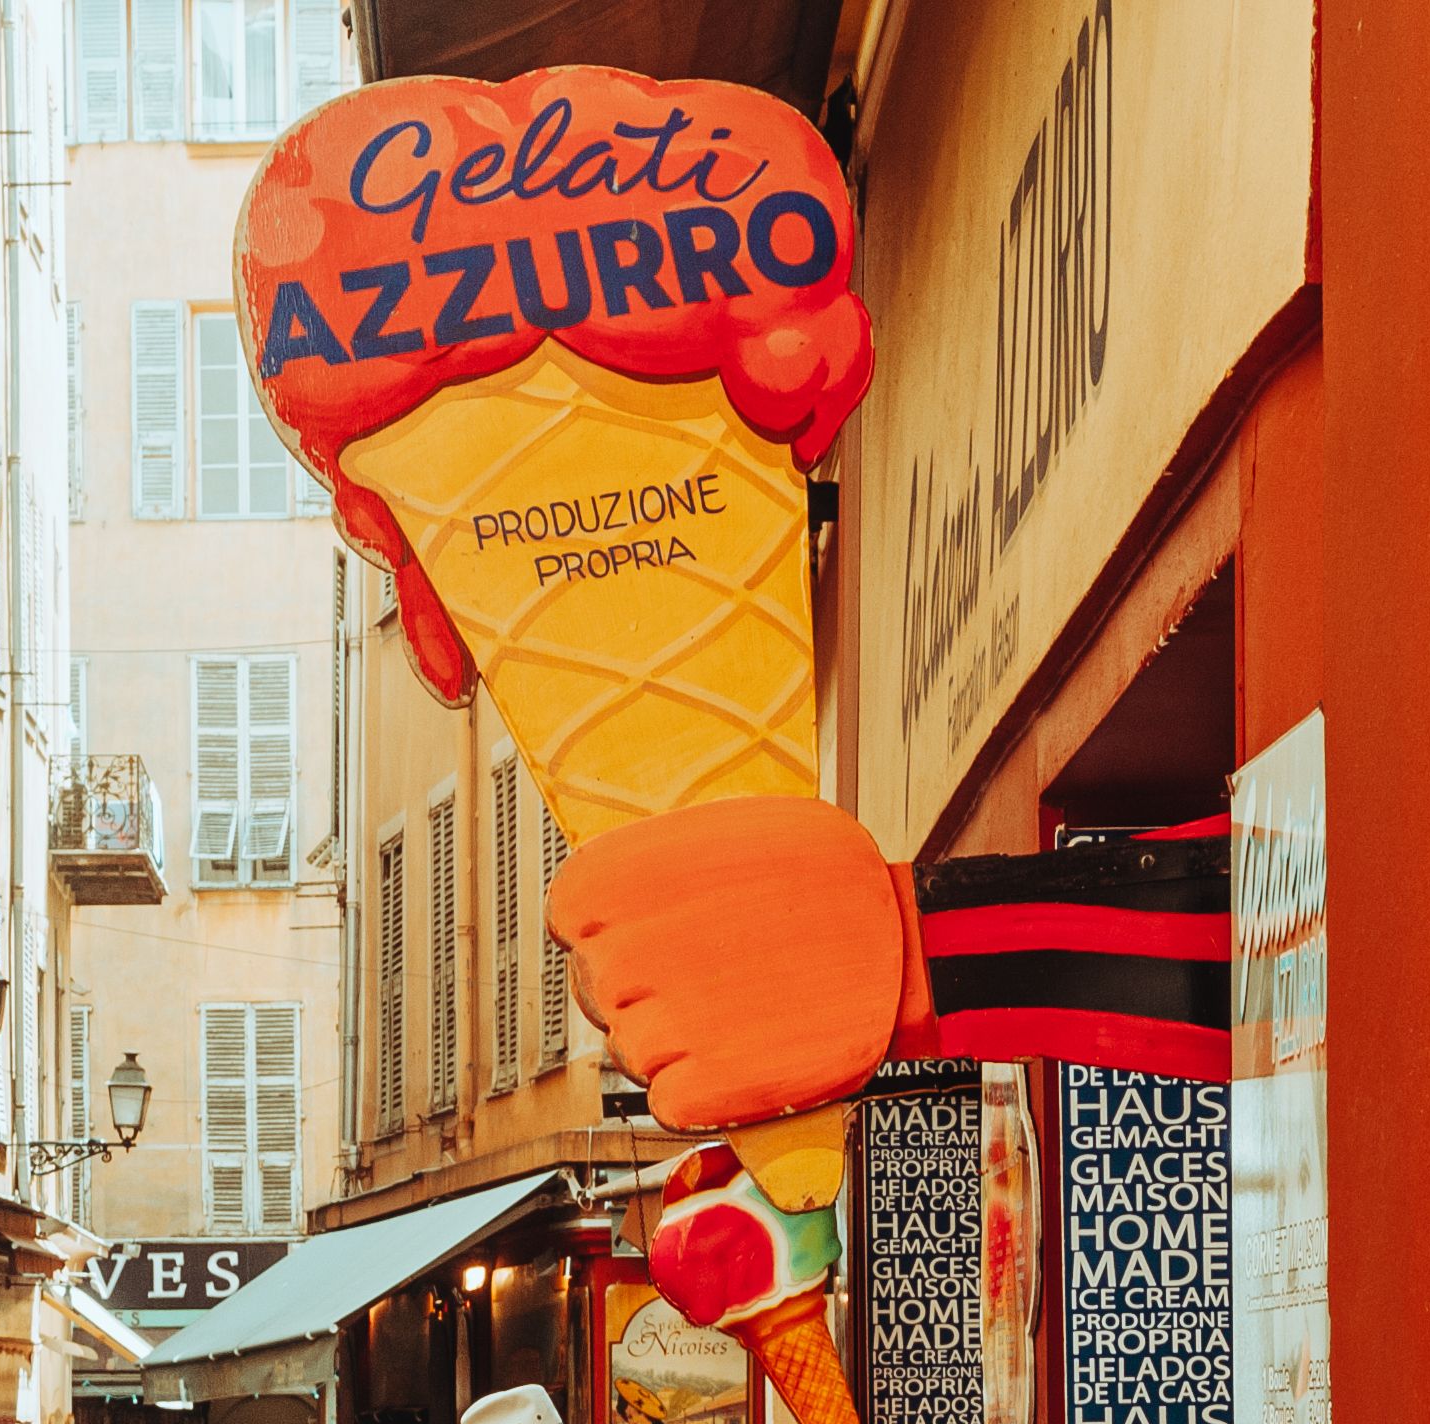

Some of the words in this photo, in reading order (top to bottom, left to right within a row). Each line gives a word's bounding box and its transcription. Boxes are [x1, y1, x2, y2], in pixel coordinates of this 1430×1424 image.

[349, 97, 770, 244] Gelati
[260, 190, 837, 380] AZZURRO
[901, 428, 982, 832] Gelateria
[990, 0, 1112, 576] AZZURRO
[472, 474, 727, 550] PRODUZIONE
[535, 534, 696, 587] PROPRIA
[989, 591, 1020, 696] Maison
[1069, 1065, 1105, 1087] DE
[871, 1105, 979, 1131] MADE
[1070, 1086, 1227, 1126] HAUS
[870, 1131, 901, 1147] ICE
[907, 1131, 979, 1146] CREAM
[1071, 1125, 1227, 1149] GEMACHT
[871, 1148, 979, 1161] PRODUZIONE
[871, 1160, 979, 1178] PROPRIA
[1071, 1152, 1227, 1185] GLACES
[871, 1178, 980, 1197] HELADOS
[1071, 1182, 1228, 1212] MAISON
[871, 1197, 896, 1212] DE
[901, 1196, 925, 1211] LA
[930, 1196, 980, 1211] CASA
[872, 1212, 980, 1239] HAUS
[1071, 1213, 1228, 1251] HOME
[872, 1238, 981, 1255] GEMACHT
[872, 1257, 980, 1279] GLACES
[1072, 1250, 1229, 1287] MADE
[873, 1278, 981, 1298] MAISON
[1072, 1287, 1116, 1310] ICE
[1125, 1287, 1229, 1309] CREAM
[872, 1299, 980, 1324] HOME
[1072, 1311, 1229, 1330] PRODUZIONE
[1073, 1328, 1230, 1355] PROPRIA
[1074, 1356, 1231, 1382] HELADOS
[1268, 1363, 1290, 1392] Boule
[1074, 1383, 1110, 1405] DE
[1118, 1382, 1151, 1404] LA
[1159, 1381, 1231, 1403] CASA
